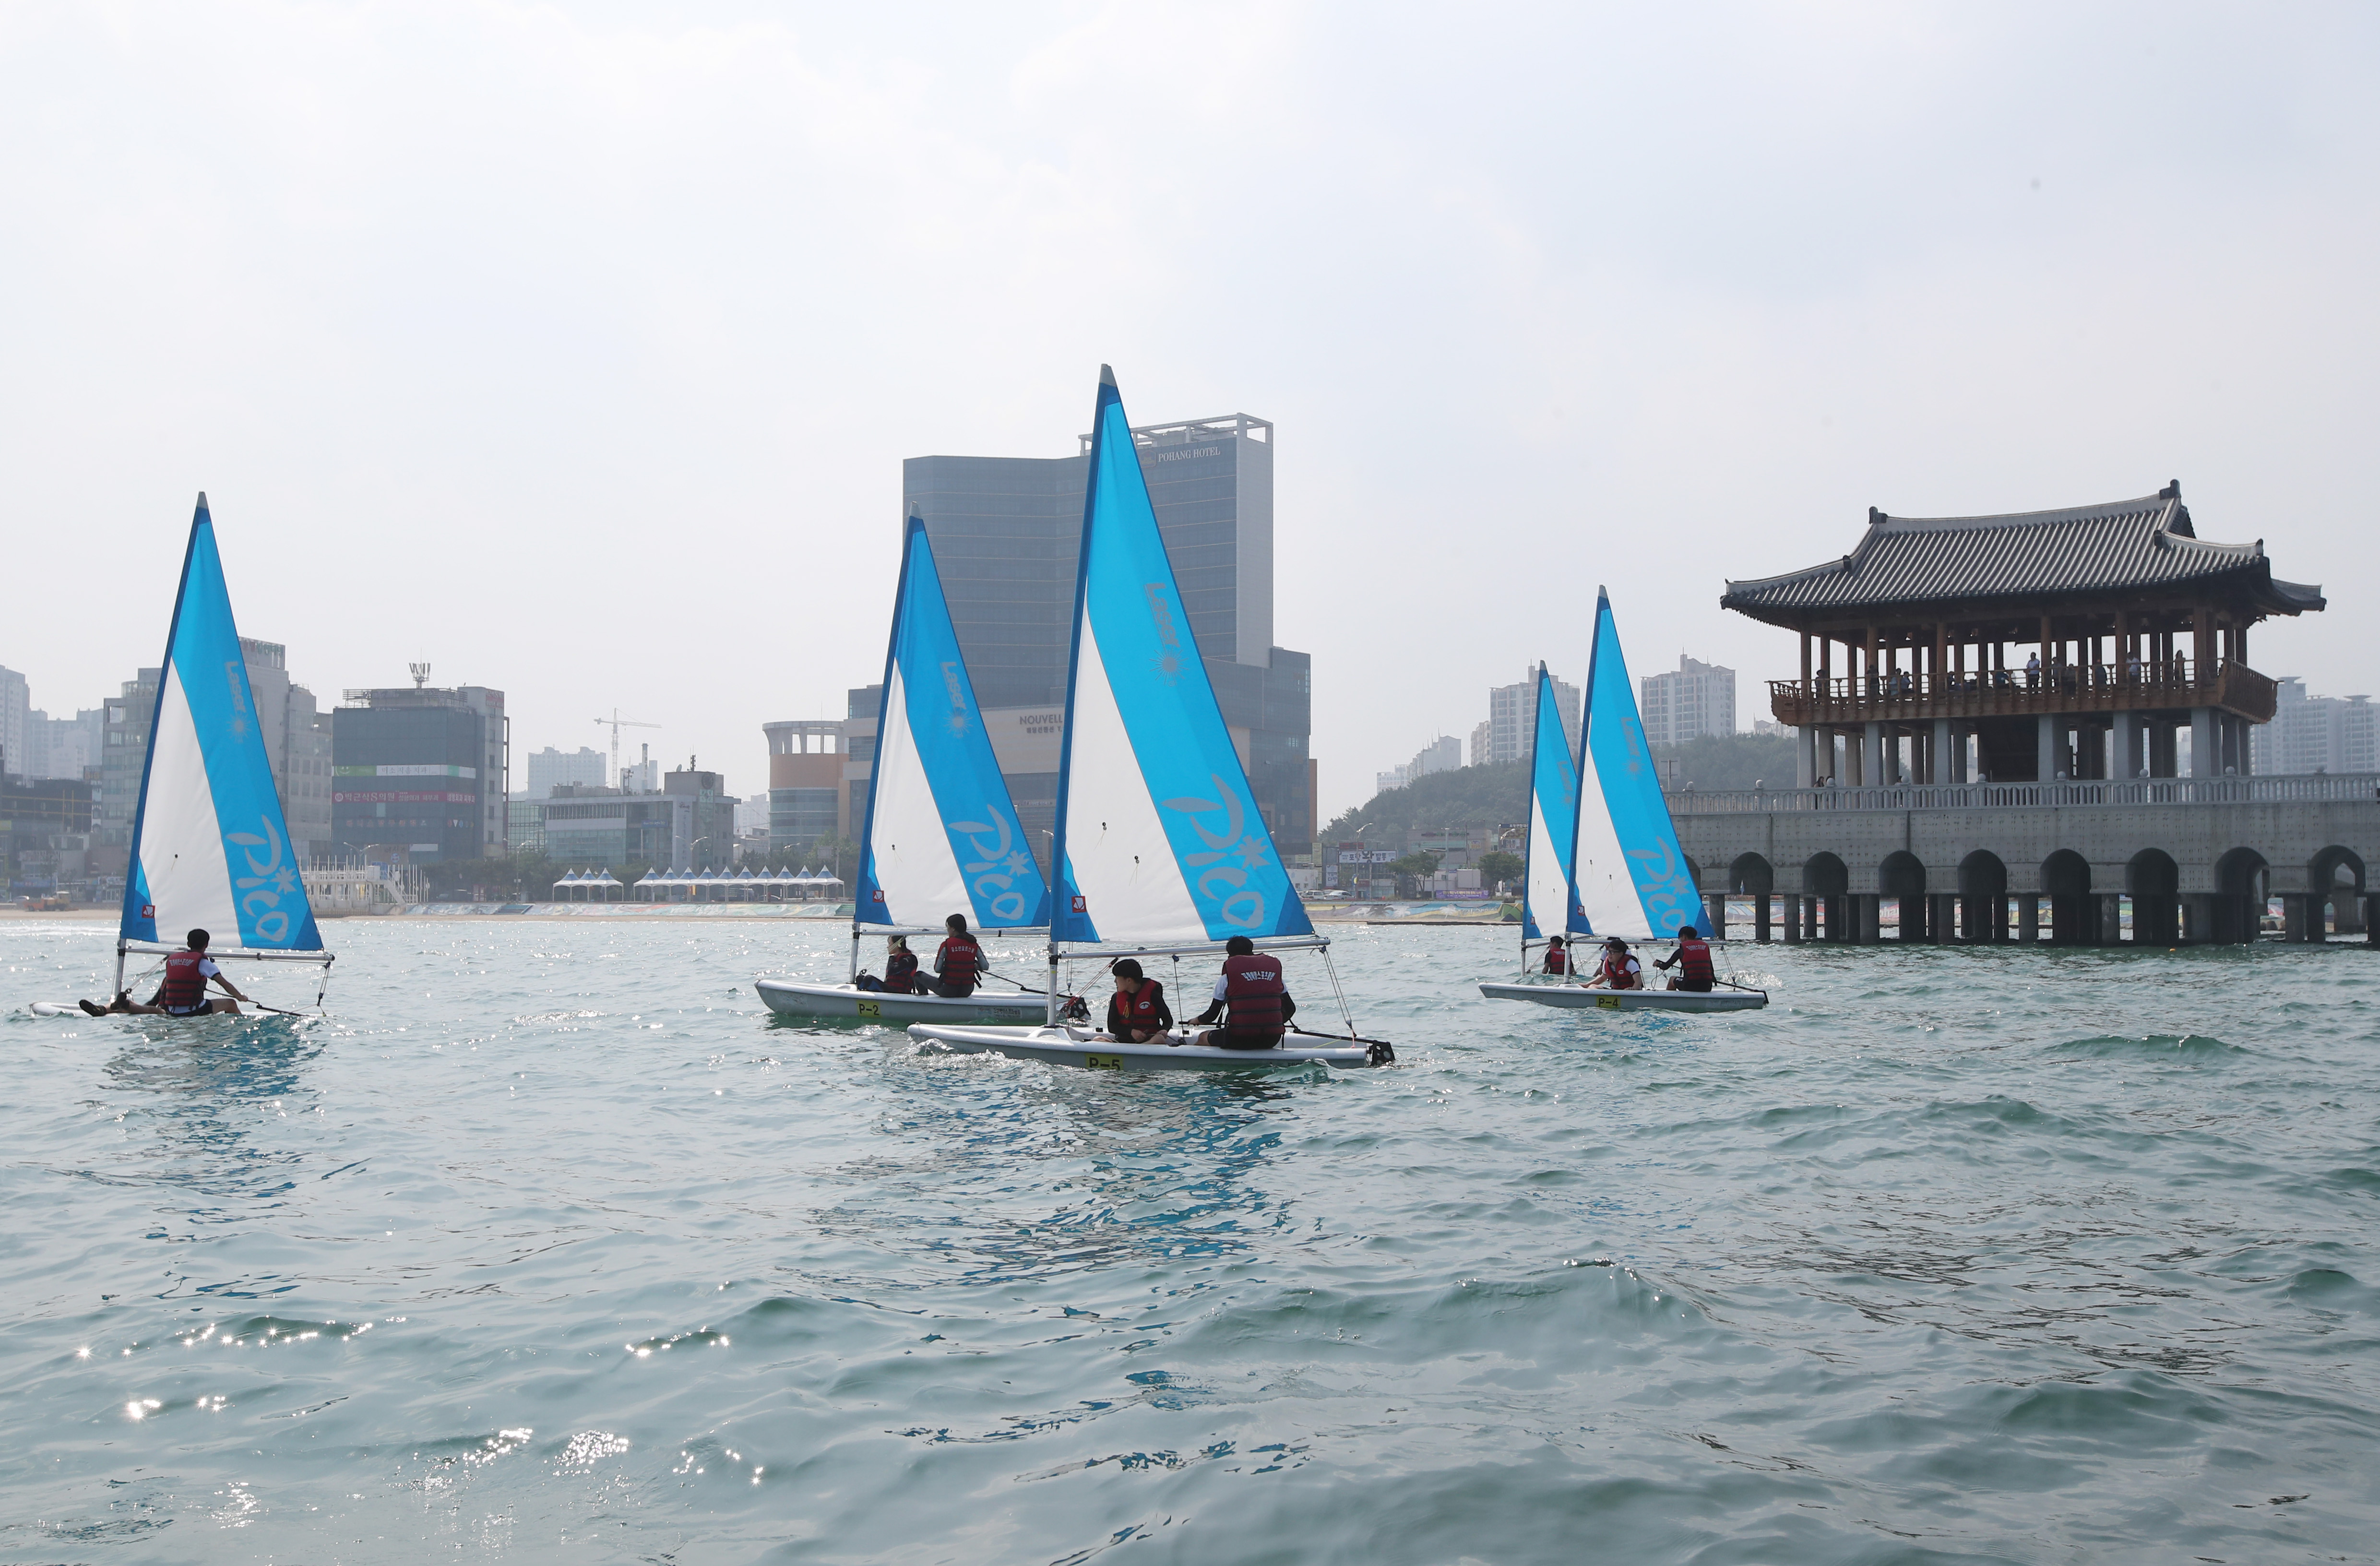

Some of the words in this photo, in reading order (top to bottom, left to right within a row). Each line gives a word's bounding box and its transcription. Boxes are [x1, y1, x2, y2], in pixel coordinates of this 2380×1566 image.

[1158, 450, 1191, 463] POHANG
[1193, 446, 1221, 458] HOTEL
[1144, 582, 1180, 649] Laser
[225, 661, 246, 713] Laser
[940, 661, 966, 710] Laser
[1020, 714, 1063, 725] NOUVELL
[1620, 717, 1641, 757] Laser
[345, 792, 395, 802] 박근식S의원
[858, 1003, 880, 1016] P-2
[1598, 998, 1619, 1008] P-4
[1089, 1057, 1121, 1070] P-5
